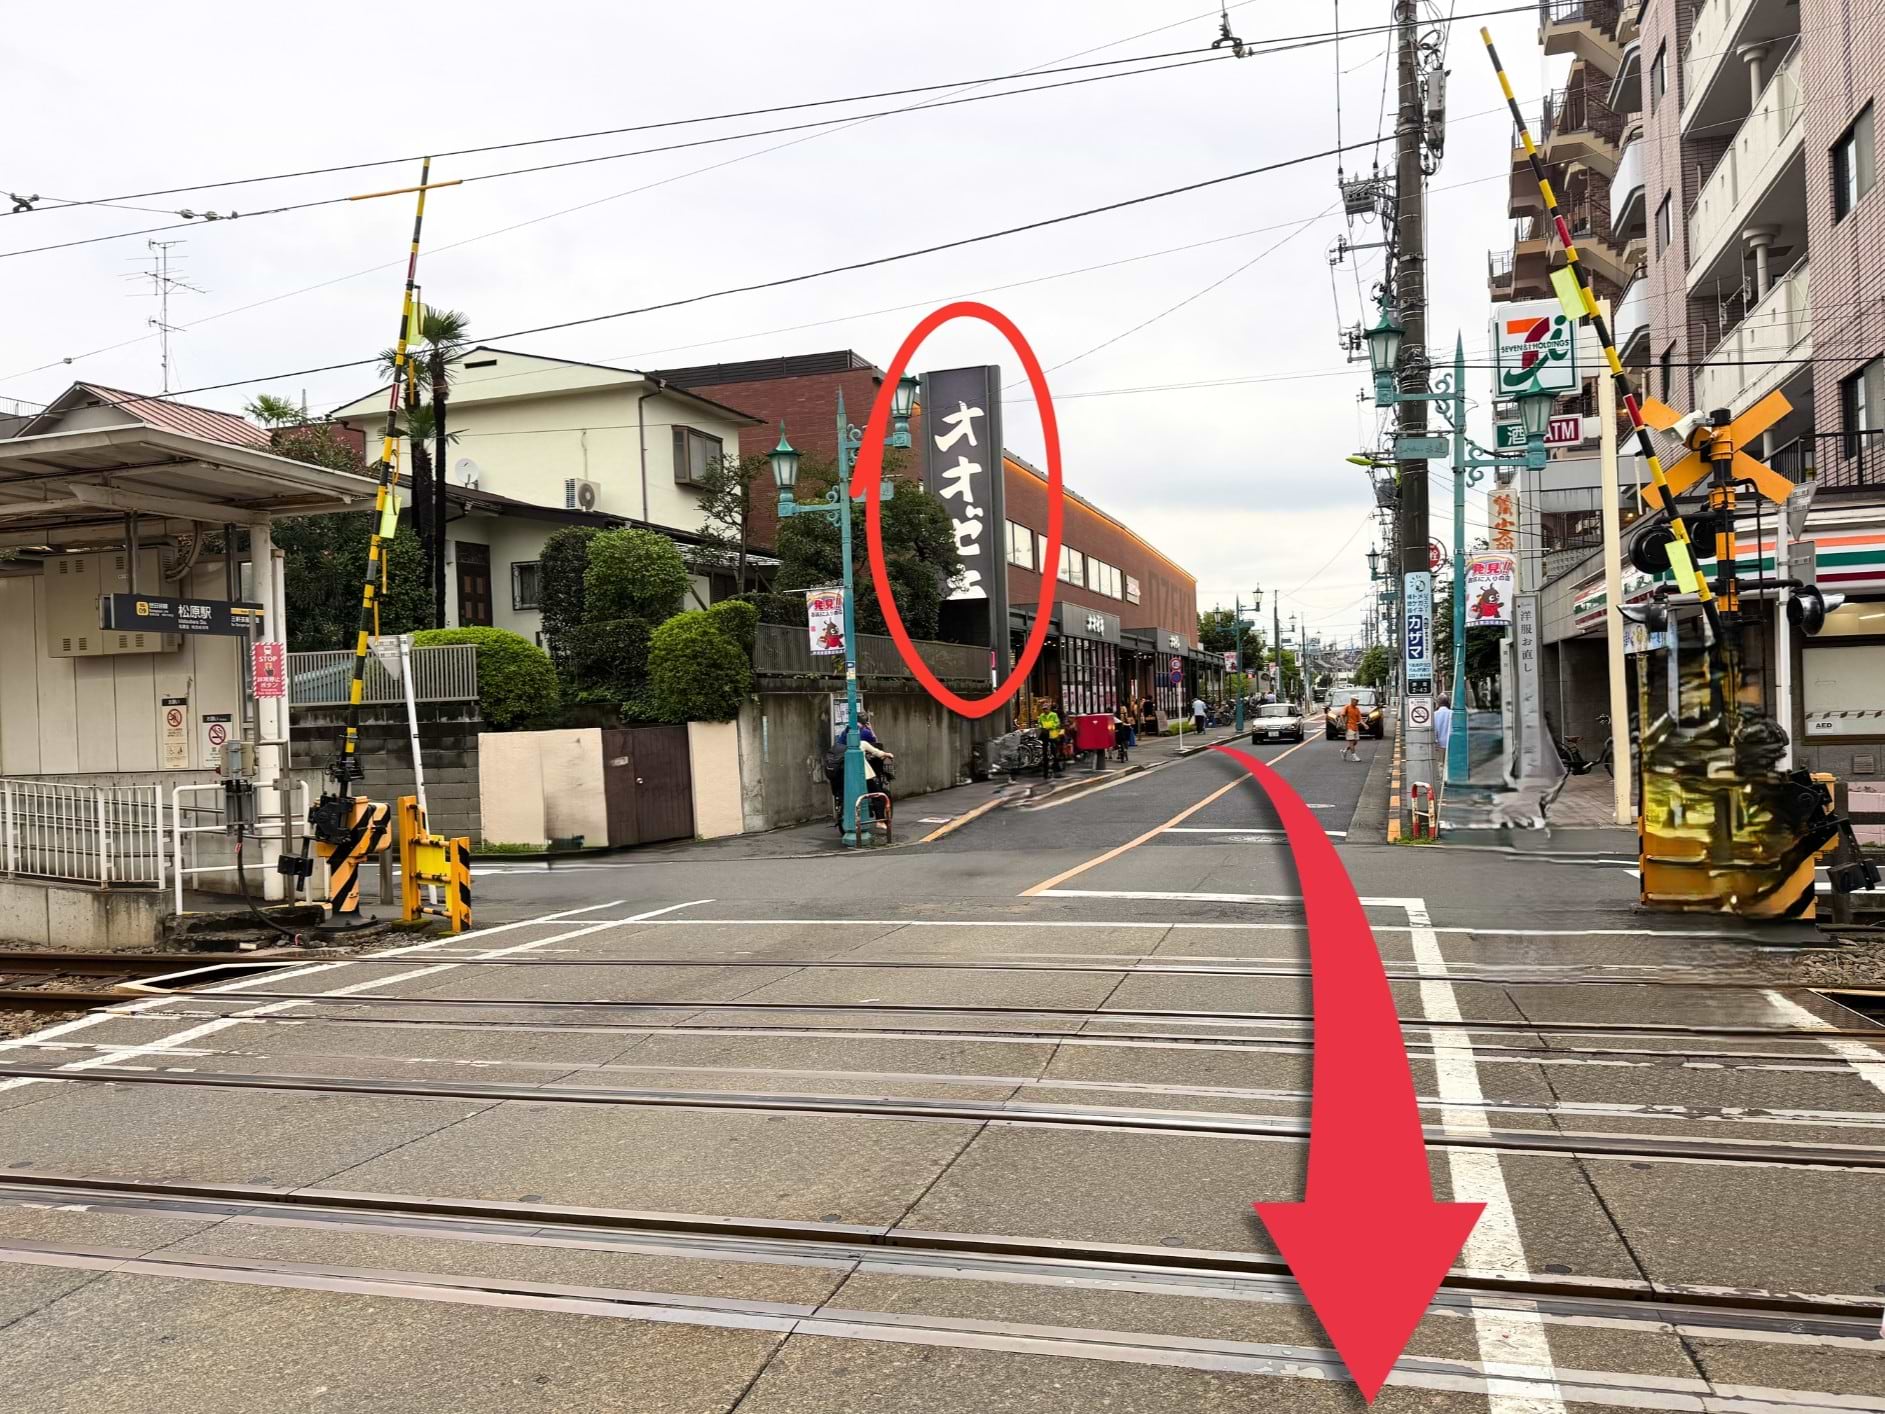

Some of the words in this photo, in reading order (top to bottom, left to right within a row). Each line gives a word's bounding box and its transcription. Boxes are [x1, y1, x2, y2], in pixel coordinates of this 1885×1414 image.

[1533, 339, 1569, 349] HOLDINGS
[1507, 426, 1527, 445] 酒
[1543, 421, 1575, 441] ATM
[178, 604, 211, 619] 松原駅
[1408, 617, 1422, 658] カザマ
